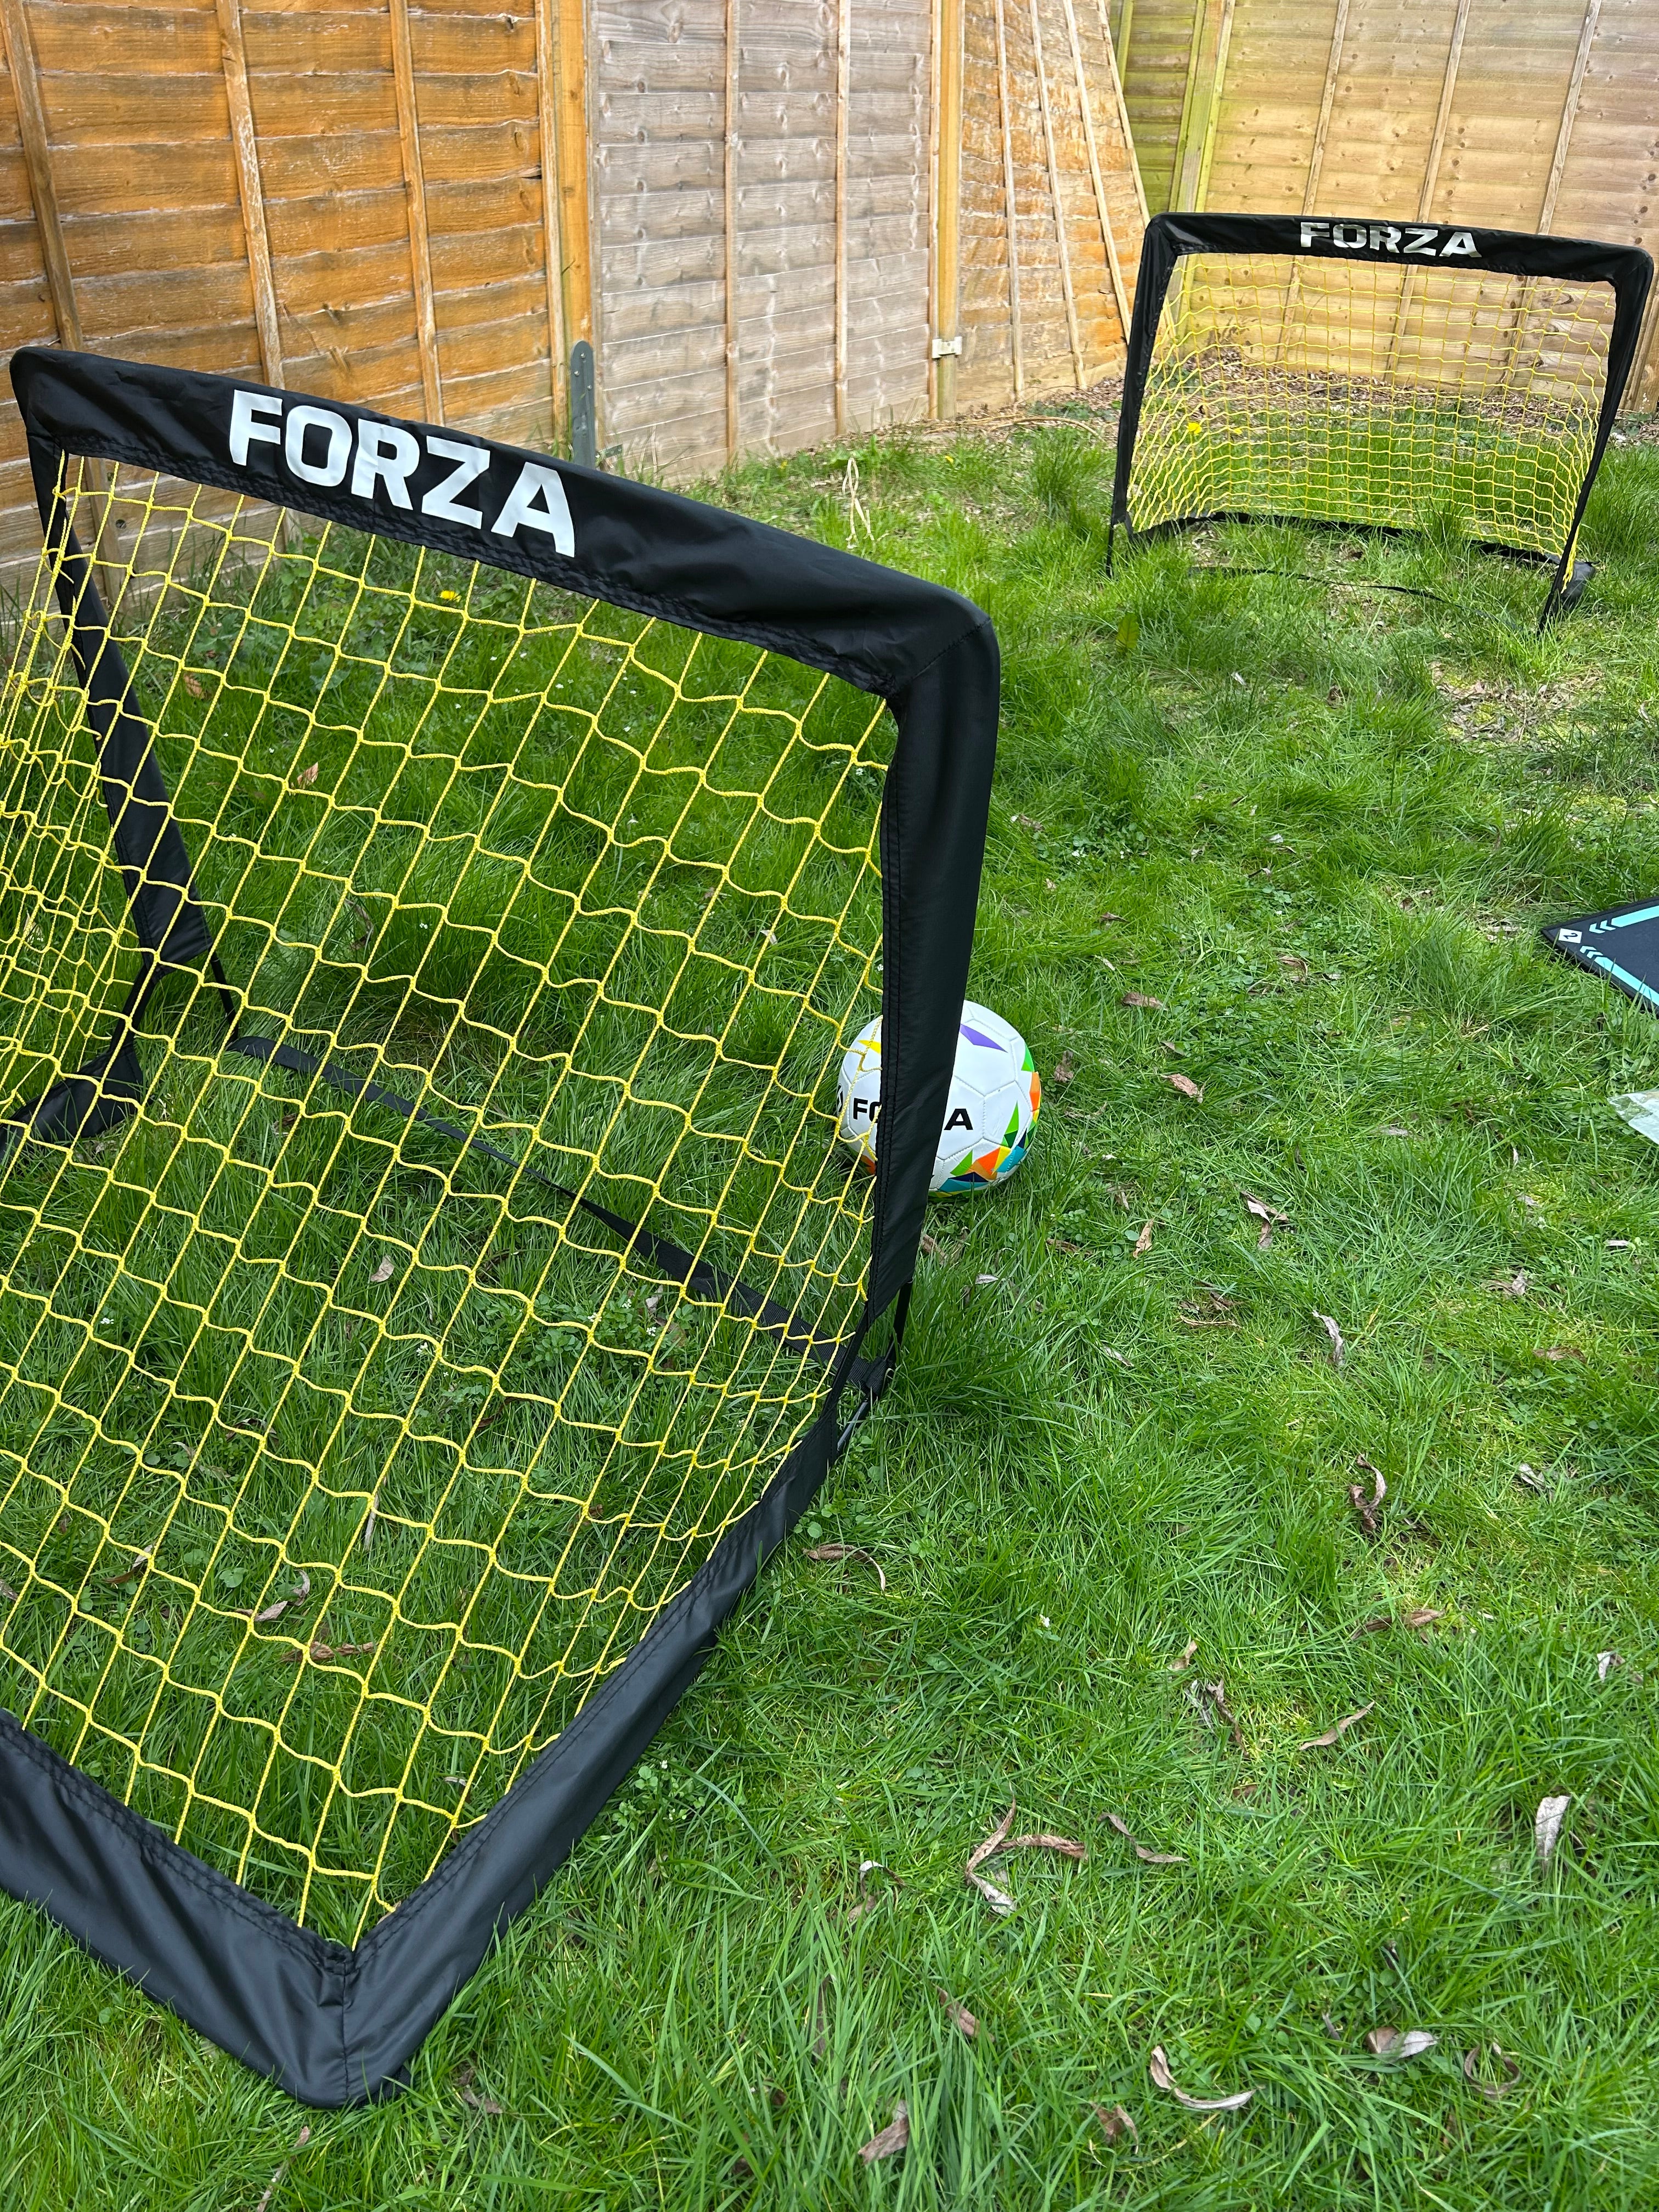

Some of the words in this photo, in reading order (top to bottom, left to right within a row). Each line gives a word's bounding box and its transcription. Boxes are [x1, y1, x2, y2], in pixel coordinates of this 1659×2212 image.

[1300, 222, 1482, 257] FORZA
[229, 389, 575, 558] FORZA
[853, 1097, 973, 1131] FOA
